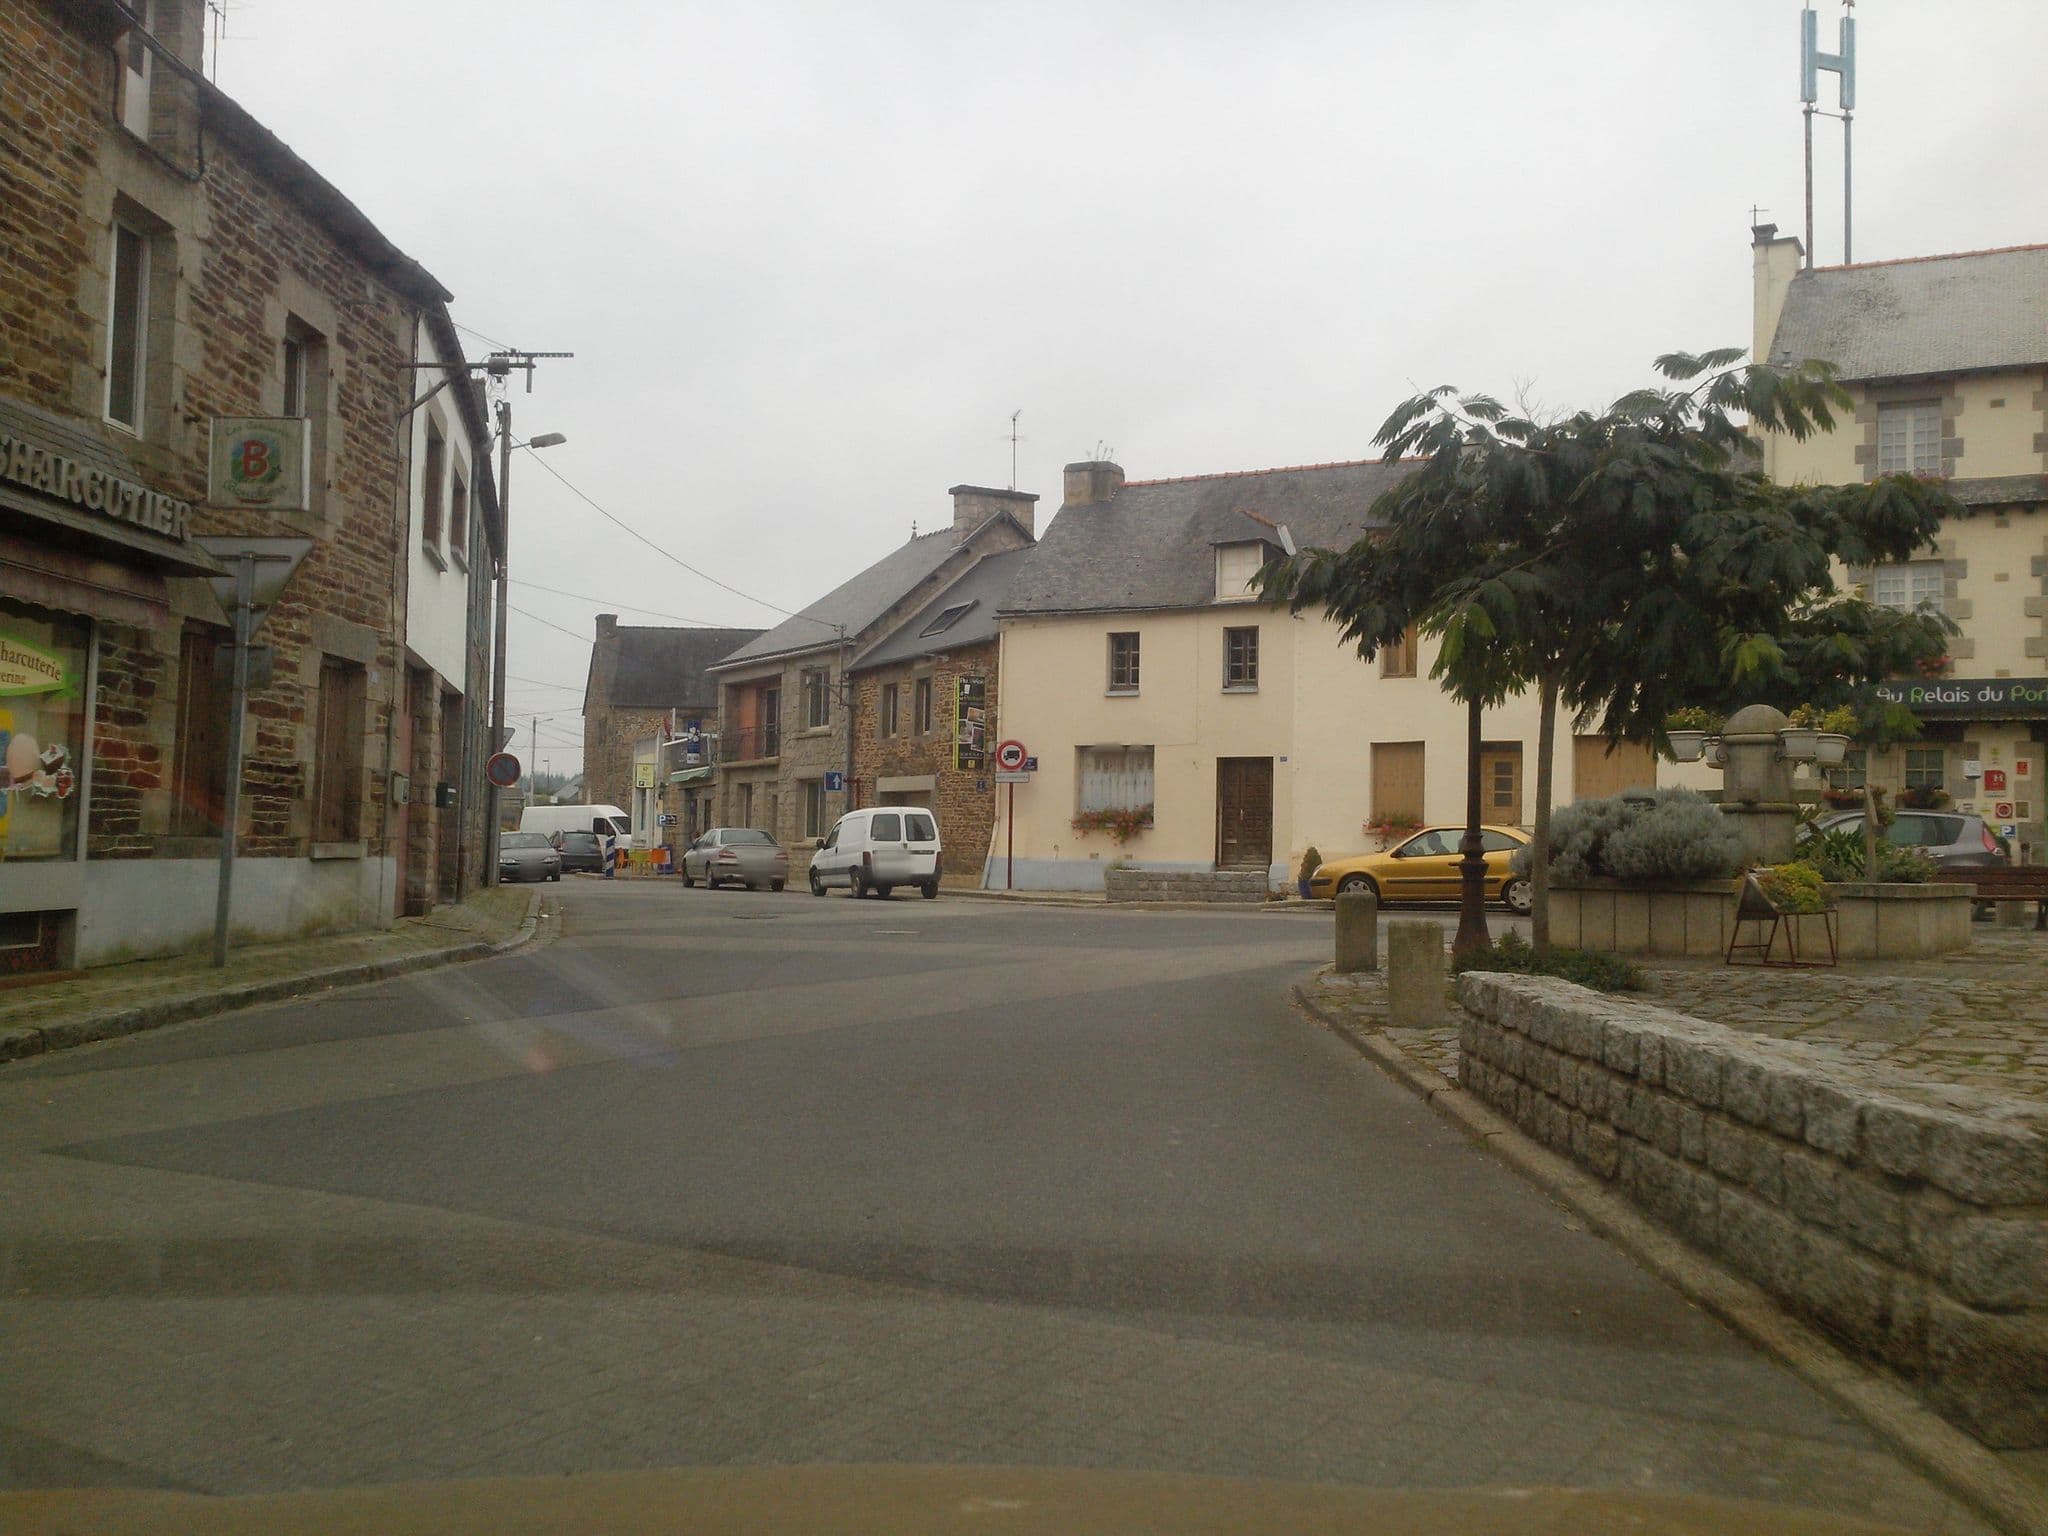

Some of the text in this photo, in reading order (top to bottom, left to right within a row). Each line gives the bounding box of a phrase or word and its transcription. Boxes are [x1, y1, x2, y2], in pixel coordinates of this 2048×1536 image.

[1800, 9, 1856, 110] H
[243, 439, 269, 477] B
[0, 640, 61, 681] harcuterie
[1876, 685, 2048, 703] Au Relais du Por
